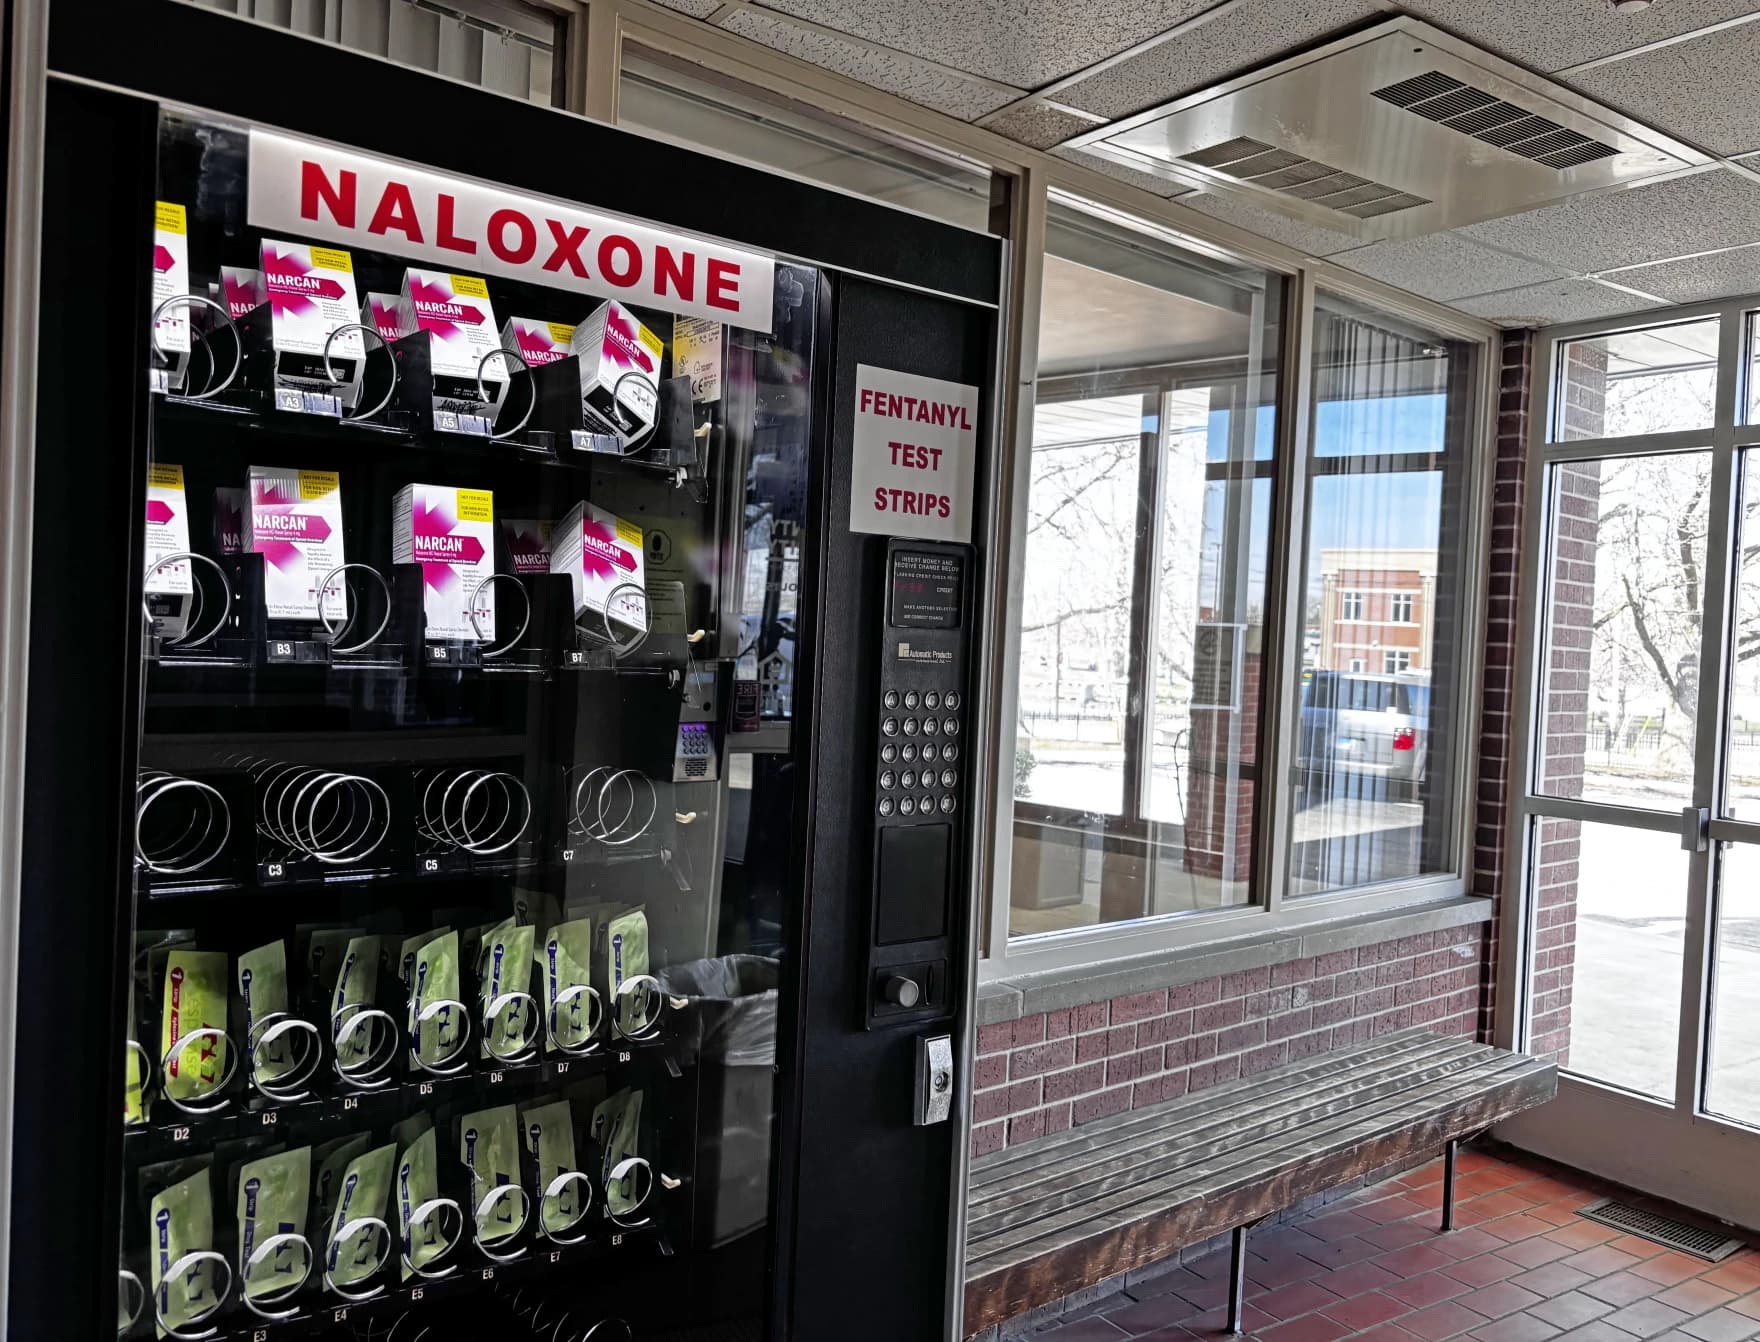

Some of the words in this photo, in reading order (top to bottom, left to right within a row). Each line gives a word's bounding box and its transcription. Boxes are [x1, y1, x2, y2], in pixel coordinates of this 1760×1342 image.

[301, 160, 741, 312] NALOXONE
[267, 273, 321, 290] NARCAN
[415, 301, 463, 316] NARCAN
[607, 324, 641, 357] NARCAN
[286, 396, 299, 408] A3
[860, 389, 972, 430] FENTANYL
[442, 417, 455, 428] A5
[580, 437, 592, 448] A7
[888, 442, 942, 471] TEST
[874, 487, 951, 518] STRIPS
[254, 514, 307, 531] NARCAN
[415, 535, 463, 552] NARCAN
[584, 534, 621, 559] NARCAN
[277, 644, 291, 656] B3
[433, 648, 446, 658] B5
[932, 650, 953, 659] Products
[571, 652, 583, 664] B7
[563, 849, 574, 862] C7
[268, 863, 283, 877] C3
[425, 859, 439, 871] C5
[619, 1051, 631, 1062] D8
[558, 1062, 570, 1073] D7
[490, 1072, 503, 1084] D6
[420, 1083, 433, 1095] D5
[344, 1098, 359, 1110] D4
[262, 1112, 277, 1125] D3
[174, 1128, 190, 1141] D2
[612, 1235, 623, 1246] E8
[550, 1251, 561, 1263] E7
[482, 1269, 494, 1280] E6
[412, 1288, 424, 1300] E5
[334, 1311, 347, 1322] E4
[254, 1331, 267, 1342] E3
